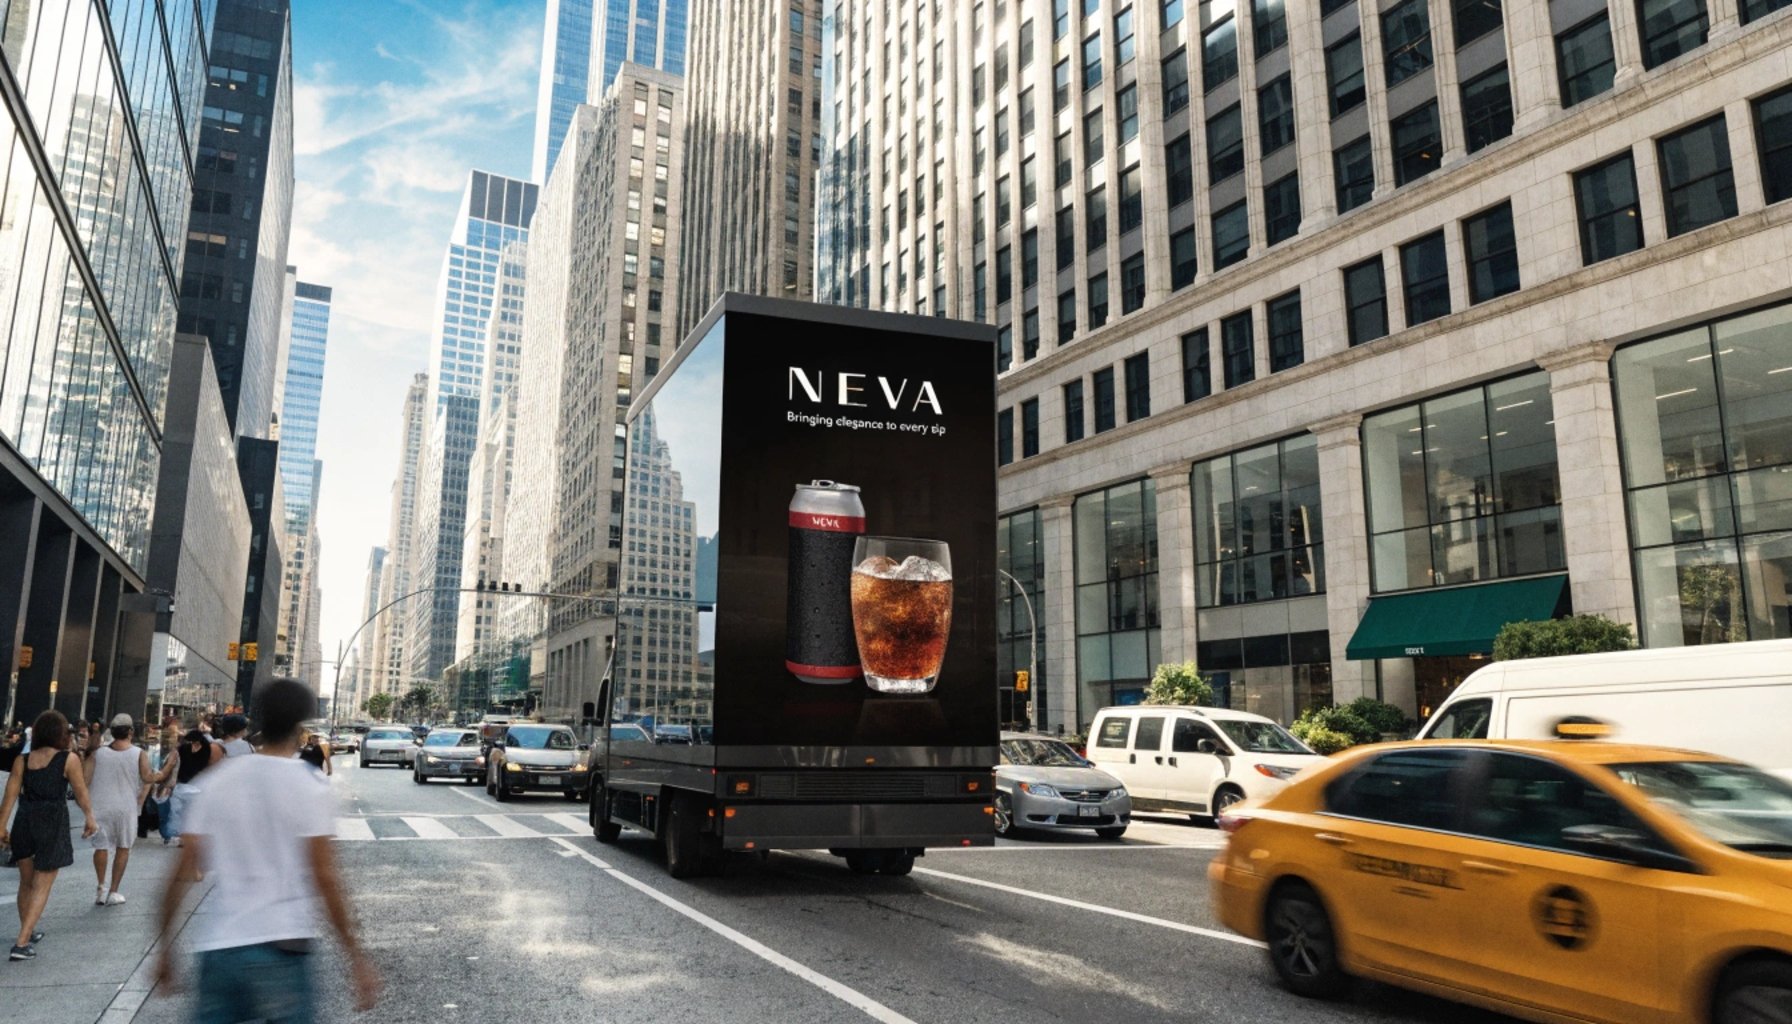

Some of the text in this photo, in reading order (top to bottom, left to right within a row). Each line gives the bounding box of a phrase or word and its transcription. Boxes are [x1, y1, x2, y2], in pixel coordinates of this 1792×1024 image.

[789, 366, 943, 415] NEVA
[787, 411, 833, 428] Bringing
[886, 421, 897, 430] to
[899, 423, 929, 436] every
[931, 423, 947, 437] sip
